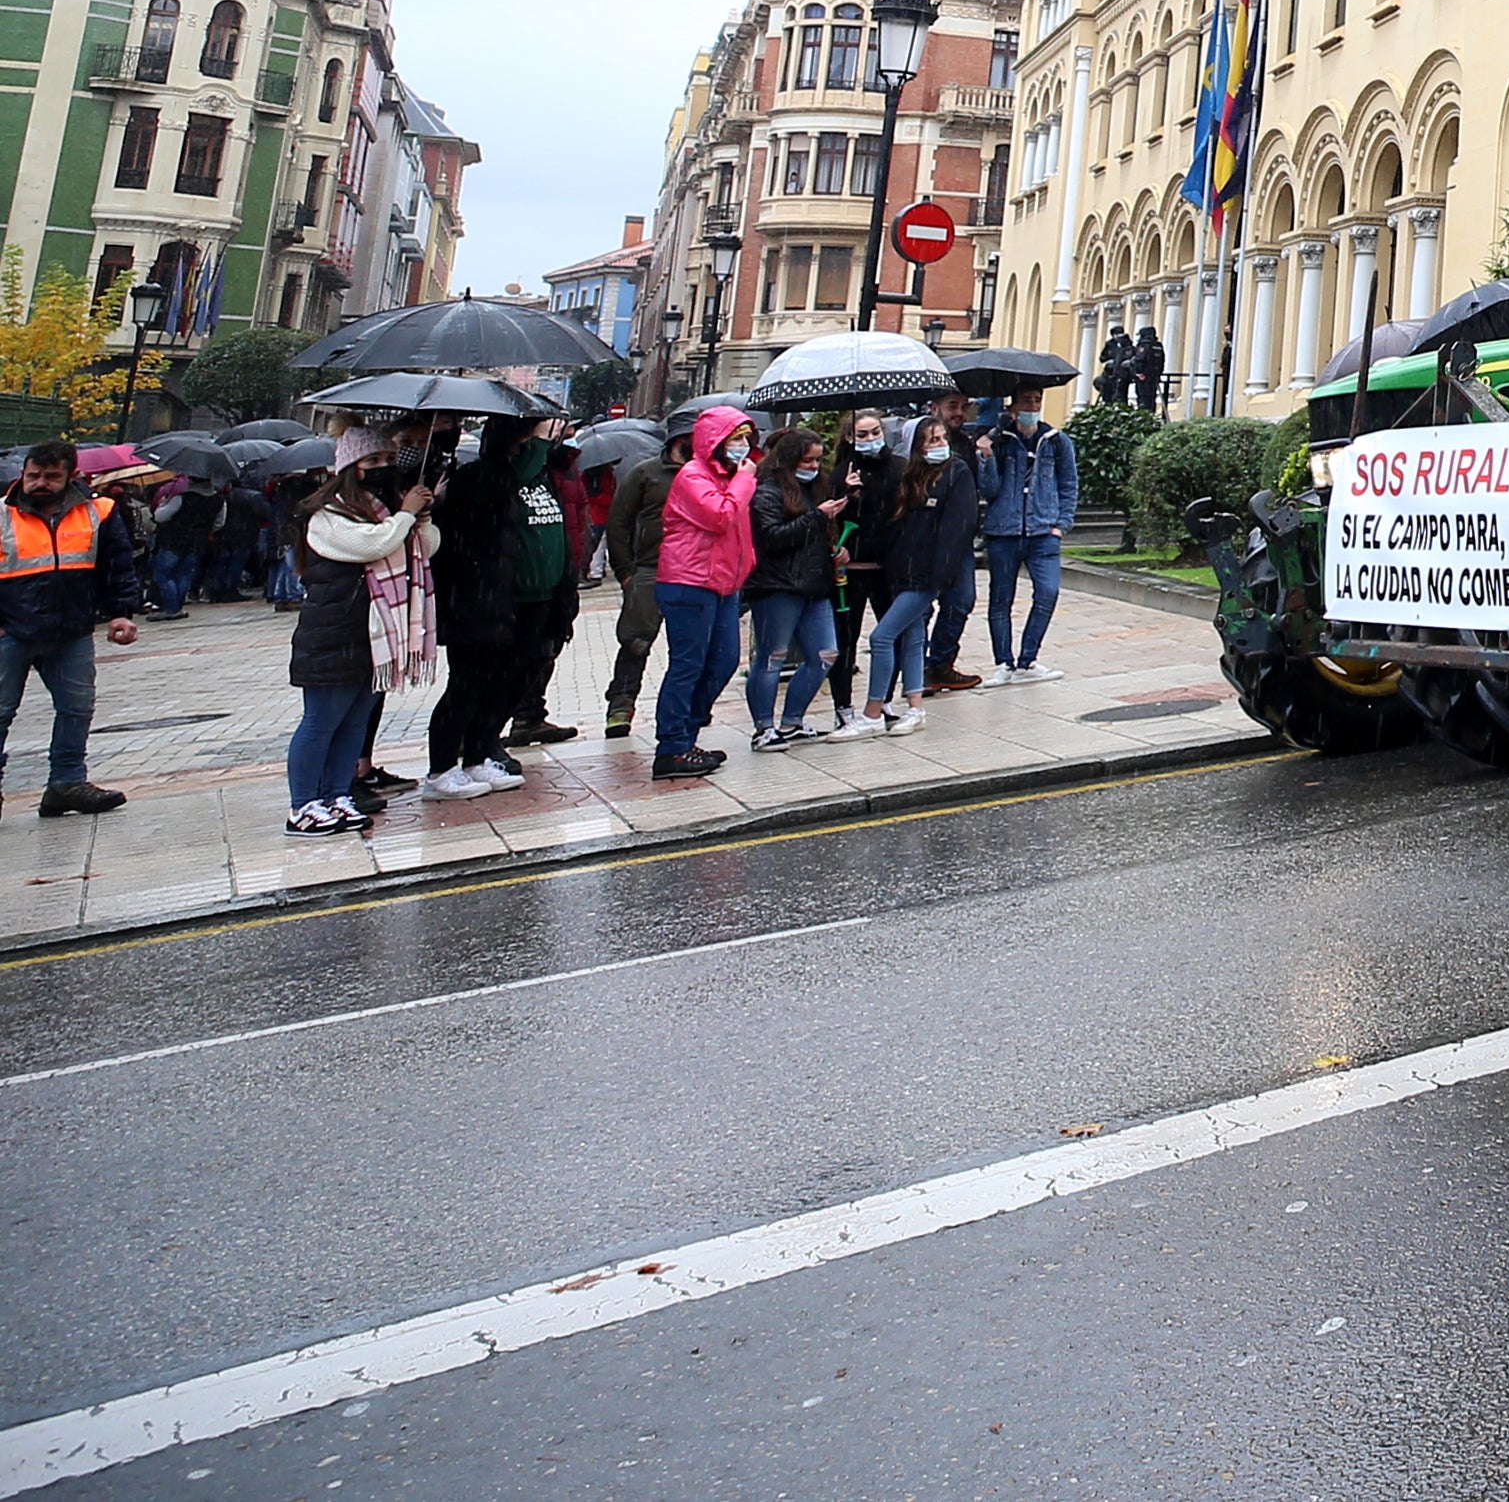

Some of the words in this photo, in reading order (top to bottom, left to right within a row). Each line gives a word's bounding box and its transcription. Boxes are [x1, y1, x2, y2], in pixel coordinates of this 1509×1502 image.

[1352, 452, 1406, 496] SOS
[1413, 448, 1509, 495] RURAL
[1341, 514, 1357, 549] SI
[1363, 515, 1382, 549] EL
[1388, 515, 1450, 551] CAMPO
[1456, 513, 1505, 560] PARA,
[1336, 564, 1353, 599] LA
[1358, 565, 1422, 603] CIUDAD
[1428, 567, 1453, 605] NO
